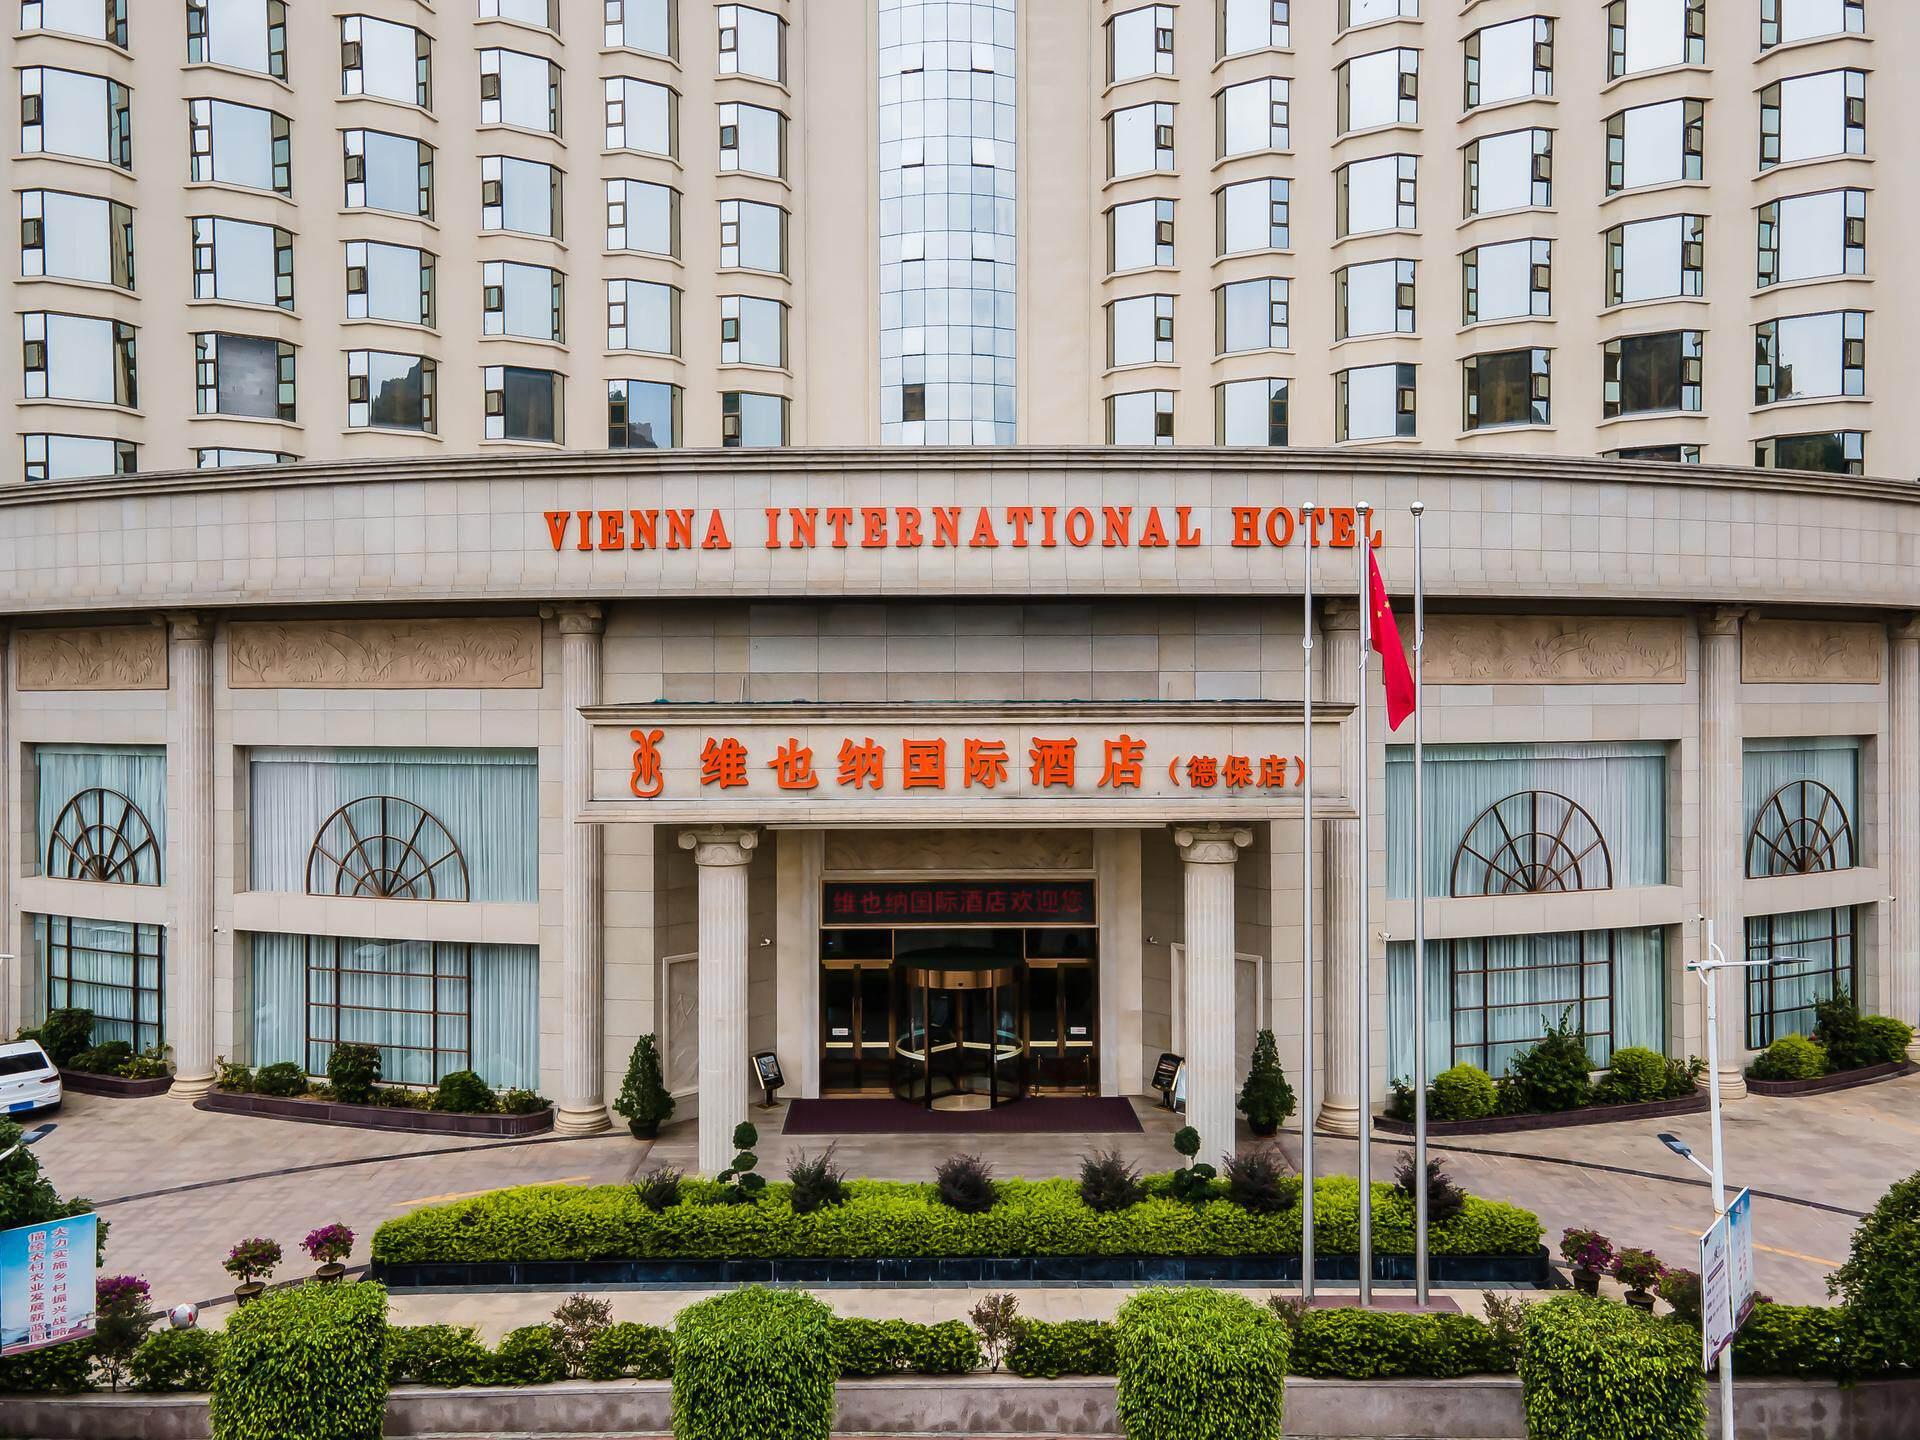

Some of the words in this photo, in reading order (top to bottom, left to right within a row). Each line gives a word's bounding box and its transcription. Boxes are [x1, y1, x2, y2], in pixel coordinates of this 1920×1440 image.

[543, 508, 732, 551] VIENNA
[765, 506, 1201, 549] INTERNATIONAL
[700, 734, 1148, 790] 维也纳国际酒店
[832, 889, 1084, 915] 维也纳国际酒店欢迎您
[51, 1226, 69, 1337] 大力实施乡村振兴战略
